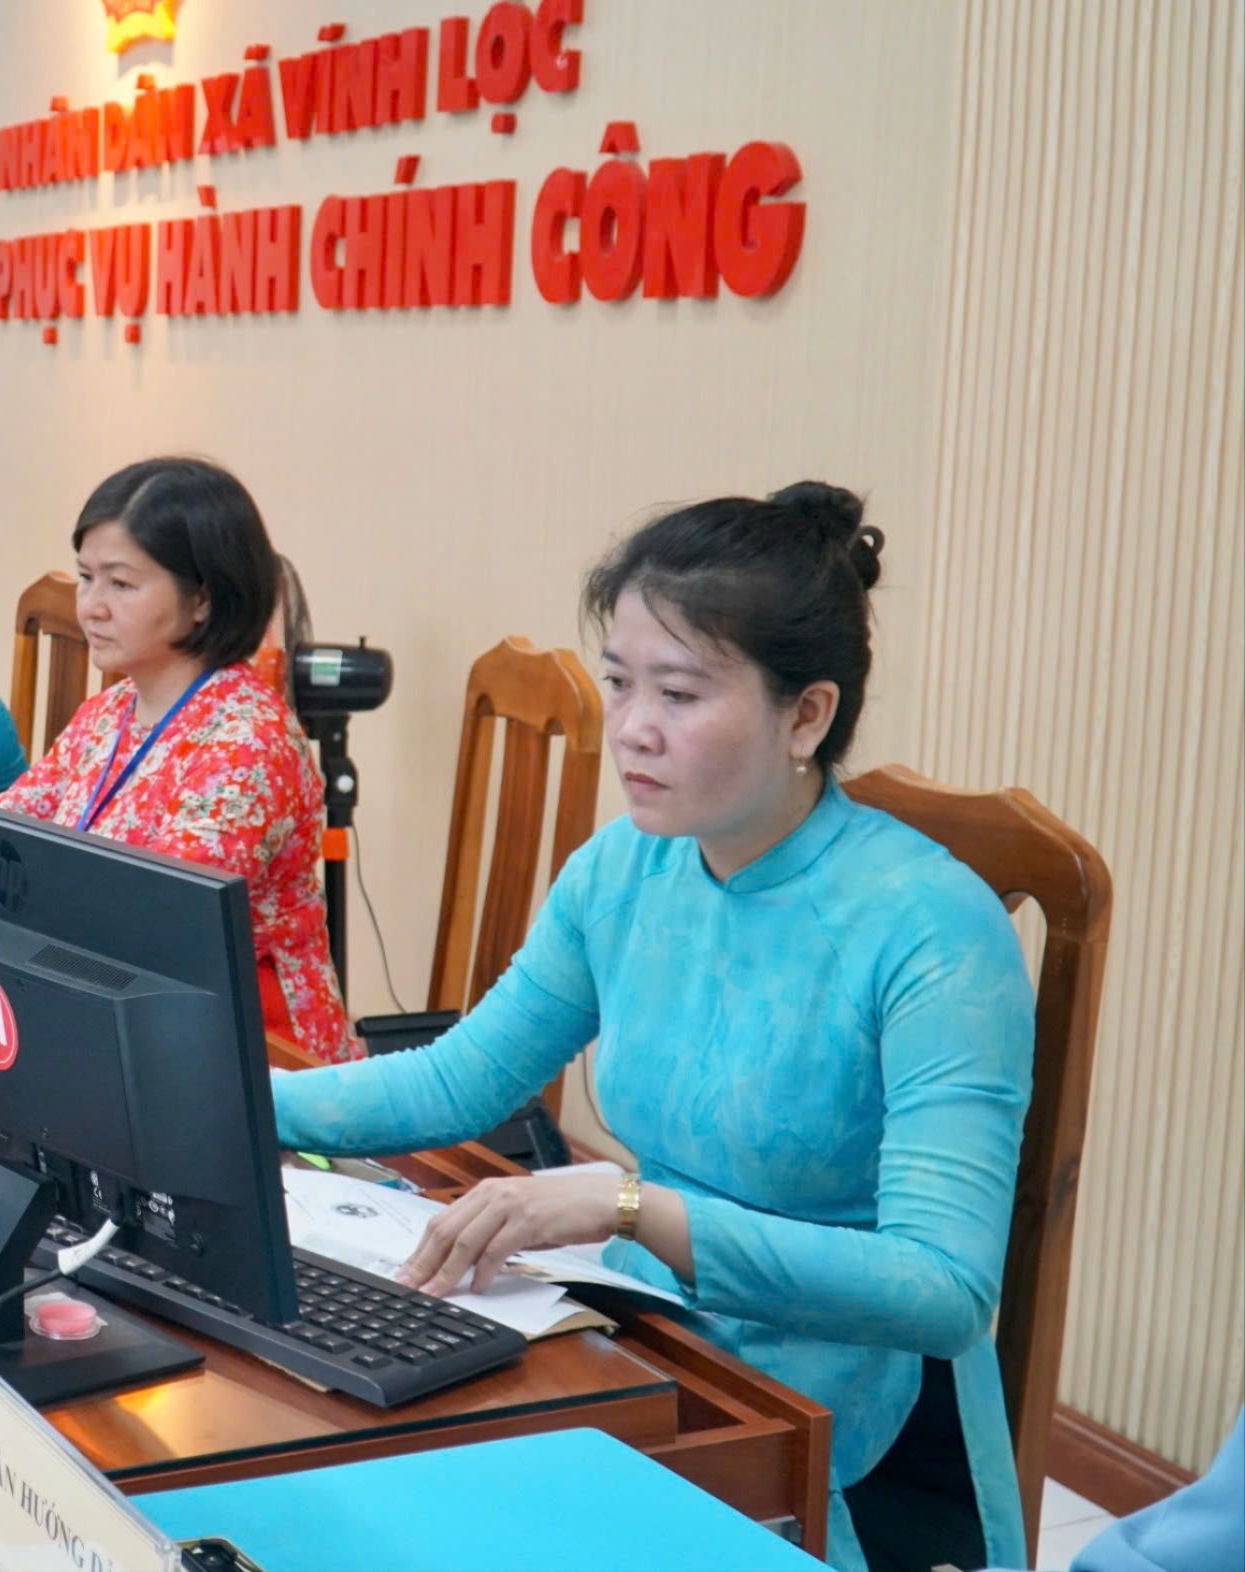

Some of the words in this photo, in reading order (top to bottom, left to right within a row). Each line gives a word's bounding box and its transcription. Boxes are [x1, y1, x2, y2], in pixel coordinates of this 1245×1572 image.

[103, 74, 196, 172] DÂN
[198, 44, 276, 156] XÃ
[88, 223, 151, 344] VỤ
[157, 185, 302, 315] HÀNH
[311, 155, 516, 310] CHÍNH
[532, 121, 806, 305] CÔNG
[21, 1480, 85, 1568] HƯỚNG
